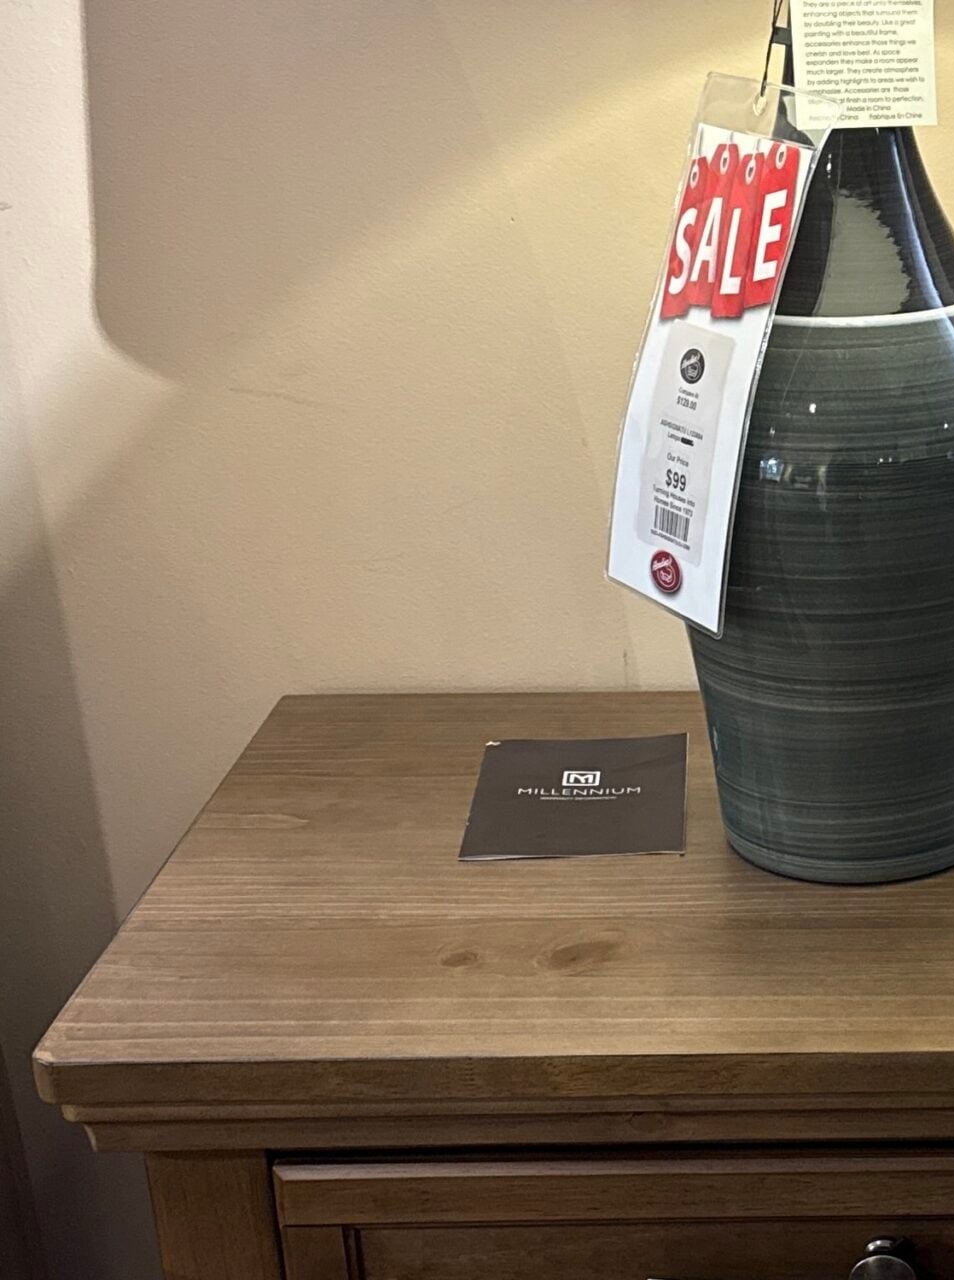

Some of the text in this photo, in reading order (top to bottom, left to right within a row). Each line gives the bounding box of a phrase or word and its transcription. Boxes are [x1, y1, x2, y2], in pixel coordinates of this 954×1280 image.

[668, 189, 788, 295] SALE
[666, 452, 689, 467] Our Price
[665, 469, 687, 492] $99
[517, 786, 641, 796] MILLENNIUM
